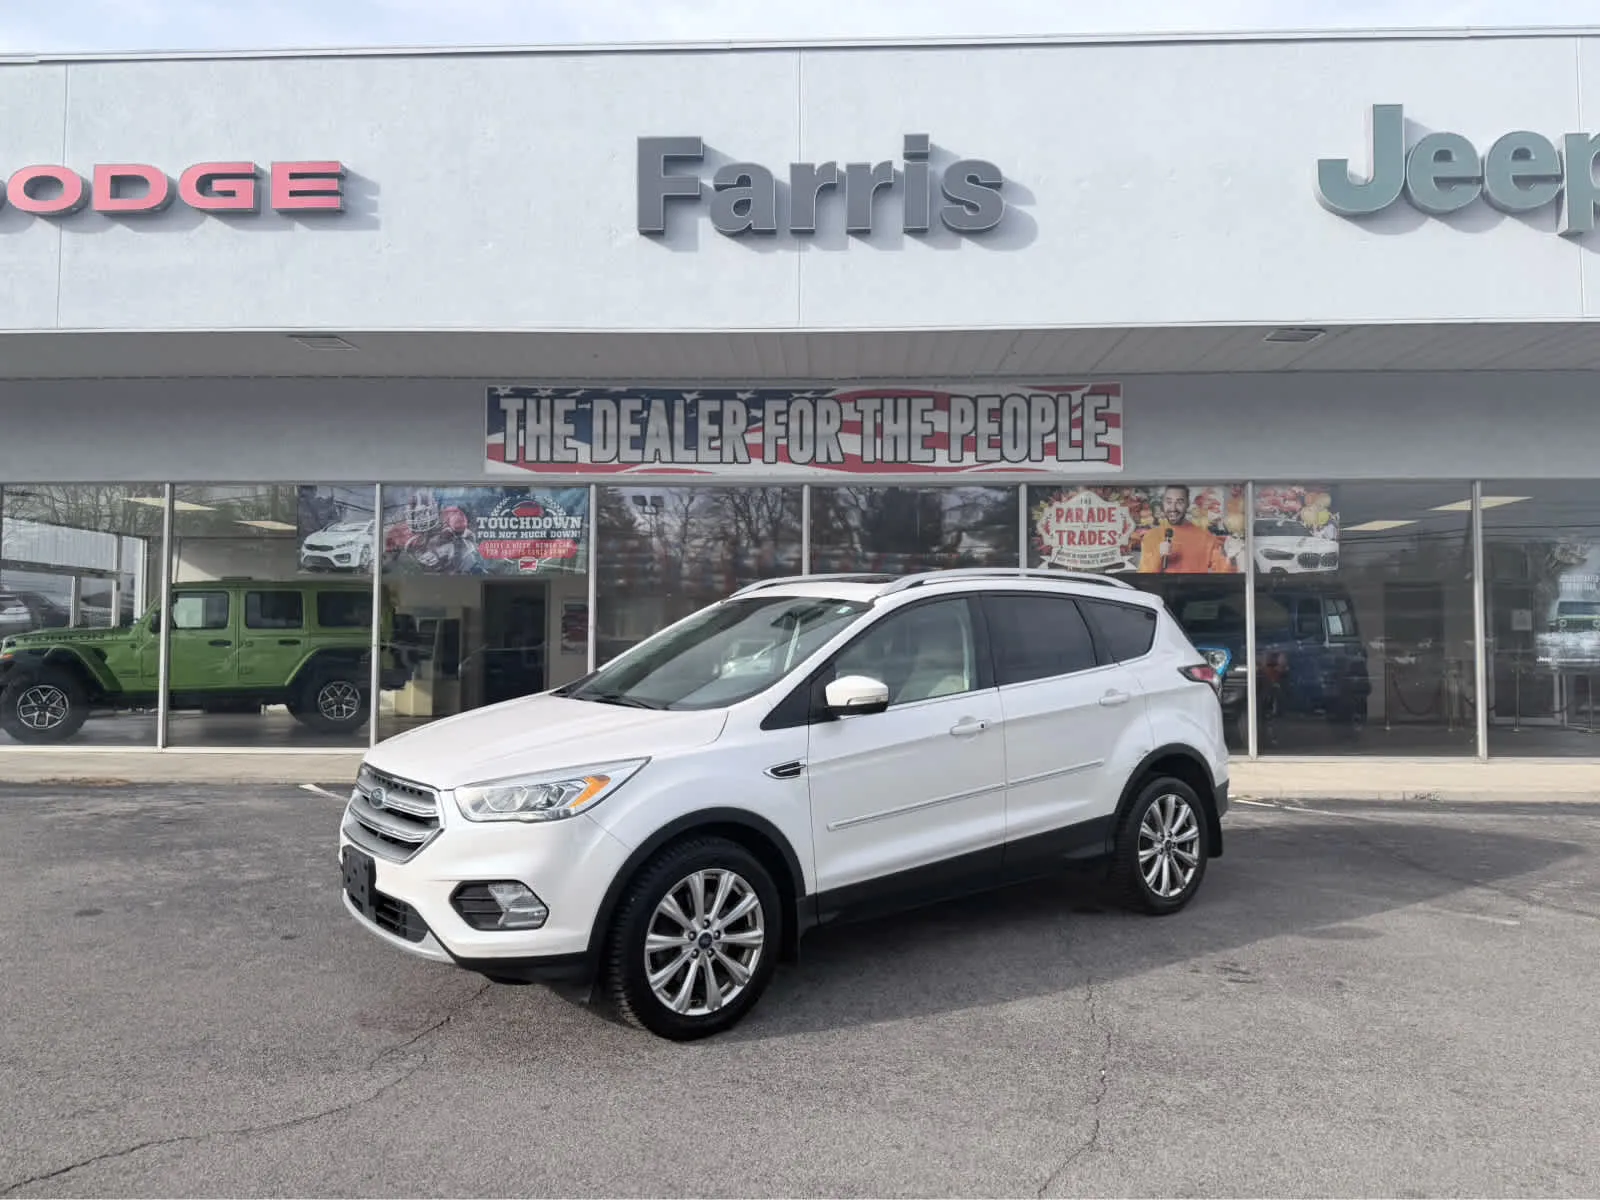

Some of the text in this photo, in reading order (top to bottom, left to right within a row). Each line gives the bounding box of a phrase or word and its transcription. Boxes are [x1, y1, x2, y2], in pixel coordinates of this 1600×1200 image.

[0, 160, 345, 214] ODGE
[637, 134, 1006, 233] Farris
[501, 393, 1110, 464] THE DEALER FOR THE PEOPLE
[476, 516, 583, 529] TOUCHDOWN
[1055, 507, 1117, 523] PARADE
[477, 530, 496, 538] FOR
[498, 530, 517, 539] NOT
[520, 530, 547, 539] MUCH
[1055, 530, 1117, 546] TRADES
